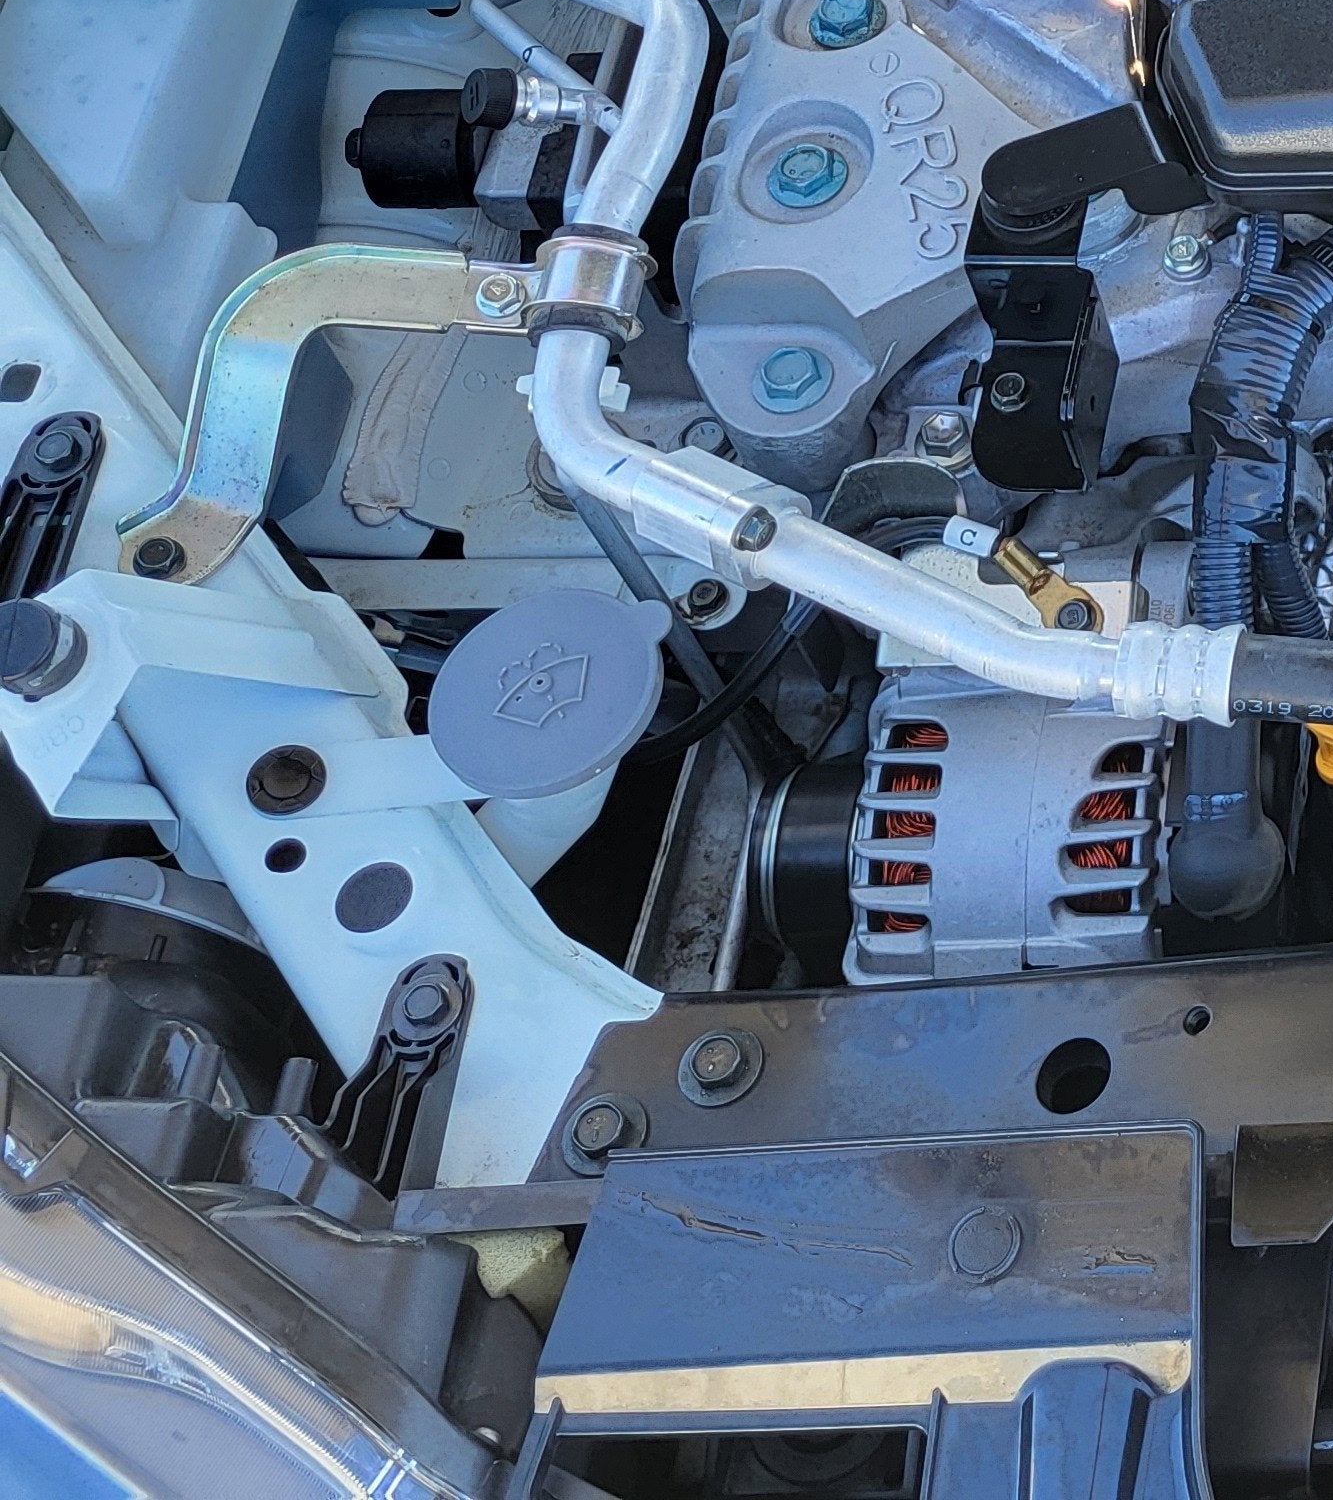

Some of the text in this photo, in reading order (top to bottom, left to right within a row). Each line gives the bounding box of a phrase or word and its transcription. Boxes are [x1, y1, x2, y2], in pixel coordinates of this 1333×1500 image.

[882, 78, 970, 260] QR25
[960, 528, 978, 547] C
[1232, 699, 1293, 716] 0319
